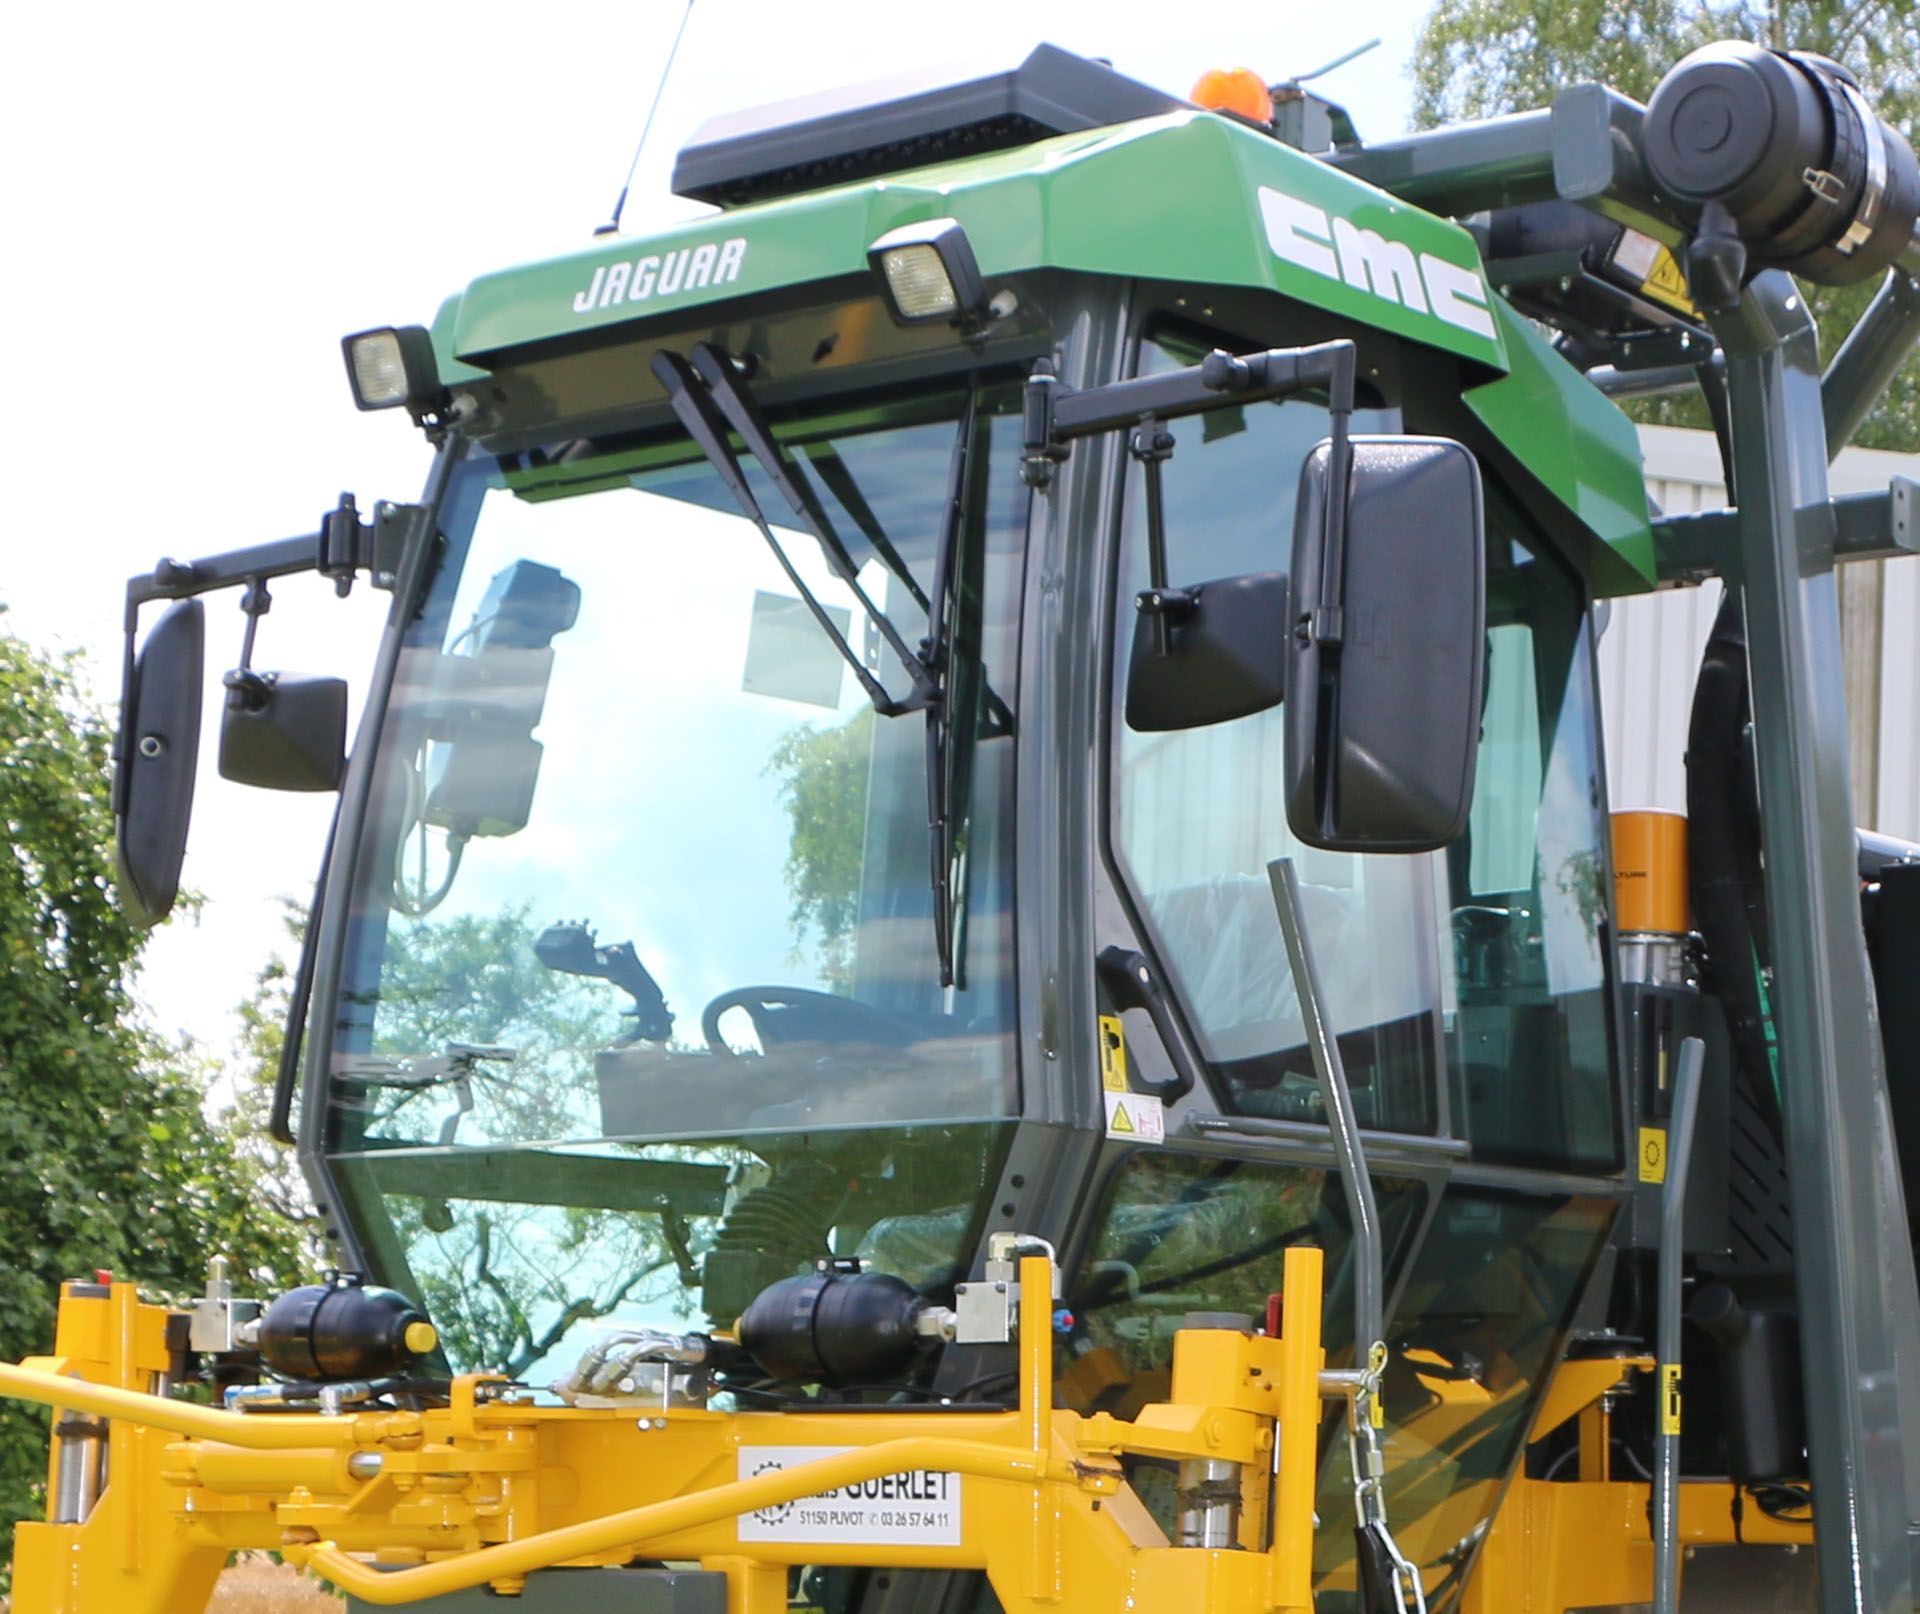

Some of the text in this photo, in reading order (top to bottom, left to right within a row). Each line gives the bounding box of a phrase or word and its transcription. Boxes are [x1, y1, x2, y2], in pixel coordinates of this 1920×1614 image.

[573, 238, 747, 312] JAGUAR
[800, 1510, 828, 1525] 51150
[881, 1511, 893, 1526] 03
[895, 1511, 907, 1526] 26
[909, 1511, 921, 1526] 57
[938, 1512, 949, 1528] 11
